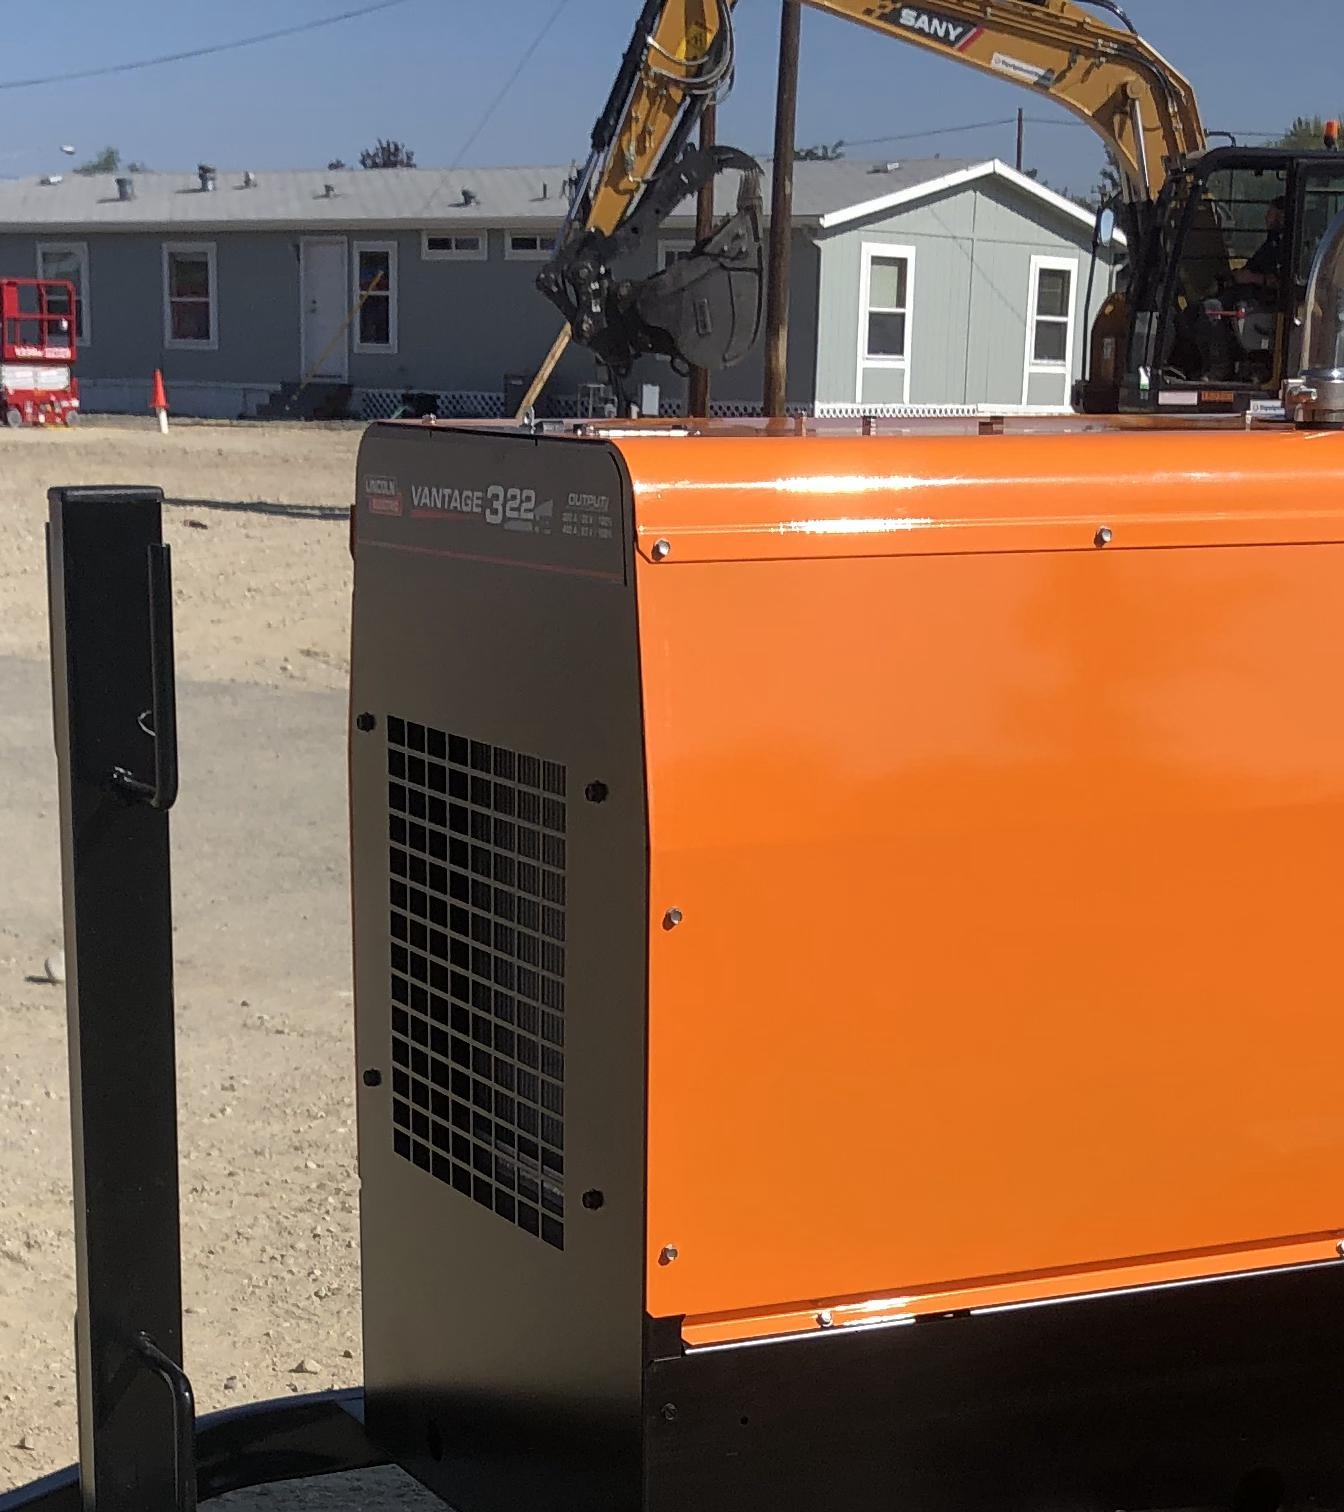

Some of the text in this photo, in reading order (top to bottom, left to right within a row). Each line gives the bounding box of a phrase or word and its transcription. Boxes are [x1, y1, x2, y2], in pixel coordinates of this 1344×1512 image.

[899, 8, 963, 42] SANY
[411, 485, 484, 513] VANTAGE
[484, 484, 537, 525] 322
[568, 492, 607, 508] OUTPUT
